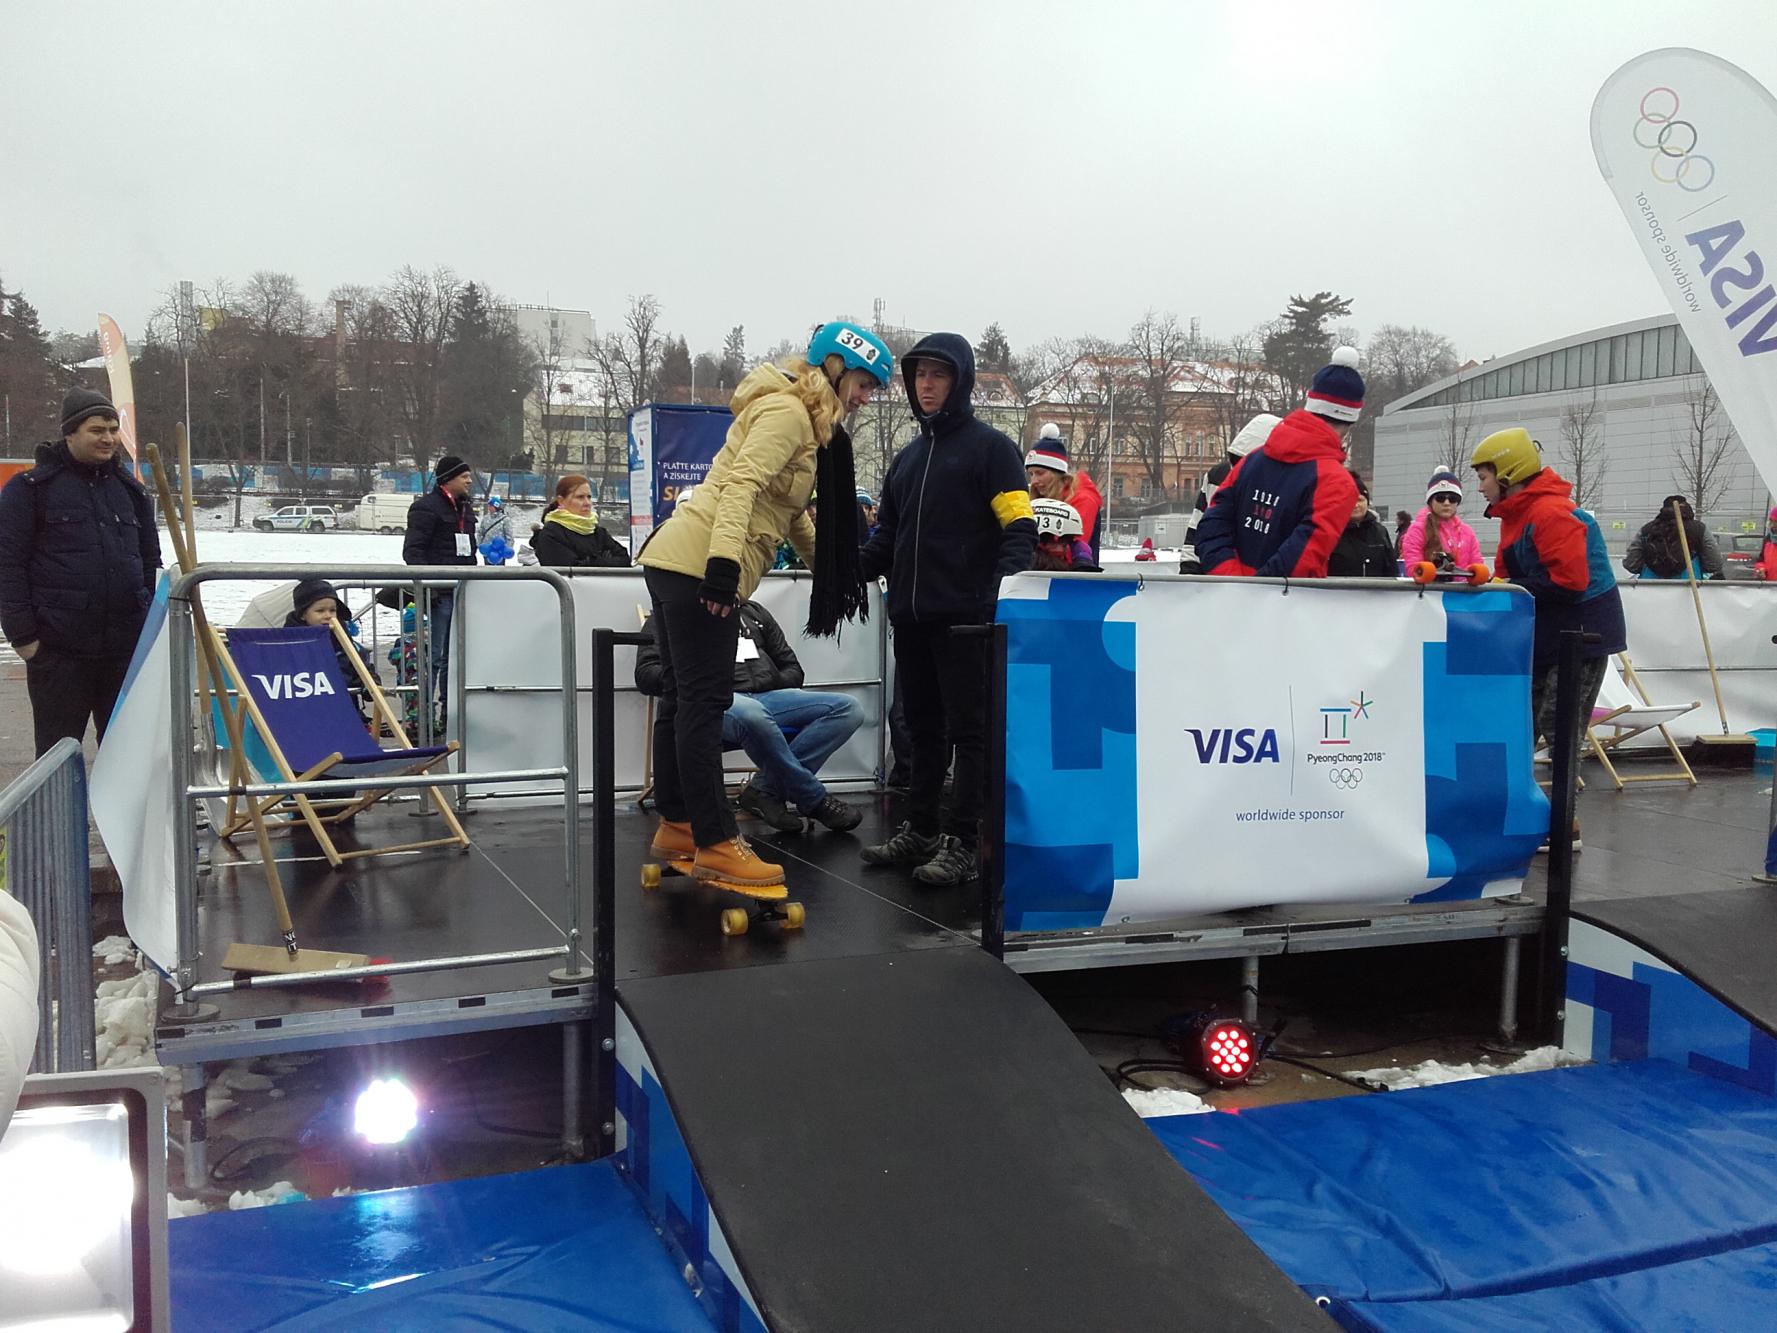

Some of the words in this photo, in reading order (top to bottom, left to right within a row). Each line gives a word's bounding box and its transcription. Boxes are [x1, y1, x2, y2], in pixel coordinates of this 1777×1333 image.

[841, 332, 864, 350] 39
[1034, 507, 1069, 518] KATEBOARD
[1244, 516, 1270, 534] 2018
[251, 671, 335, 700] VISA
[1184, 728, 1280, 764] VISA
[1307, 752, 1363, 764] PyeongChang
[1236, 808, 1296, 822] worldwide
[1299, 809, 1345, 823] sponsor
